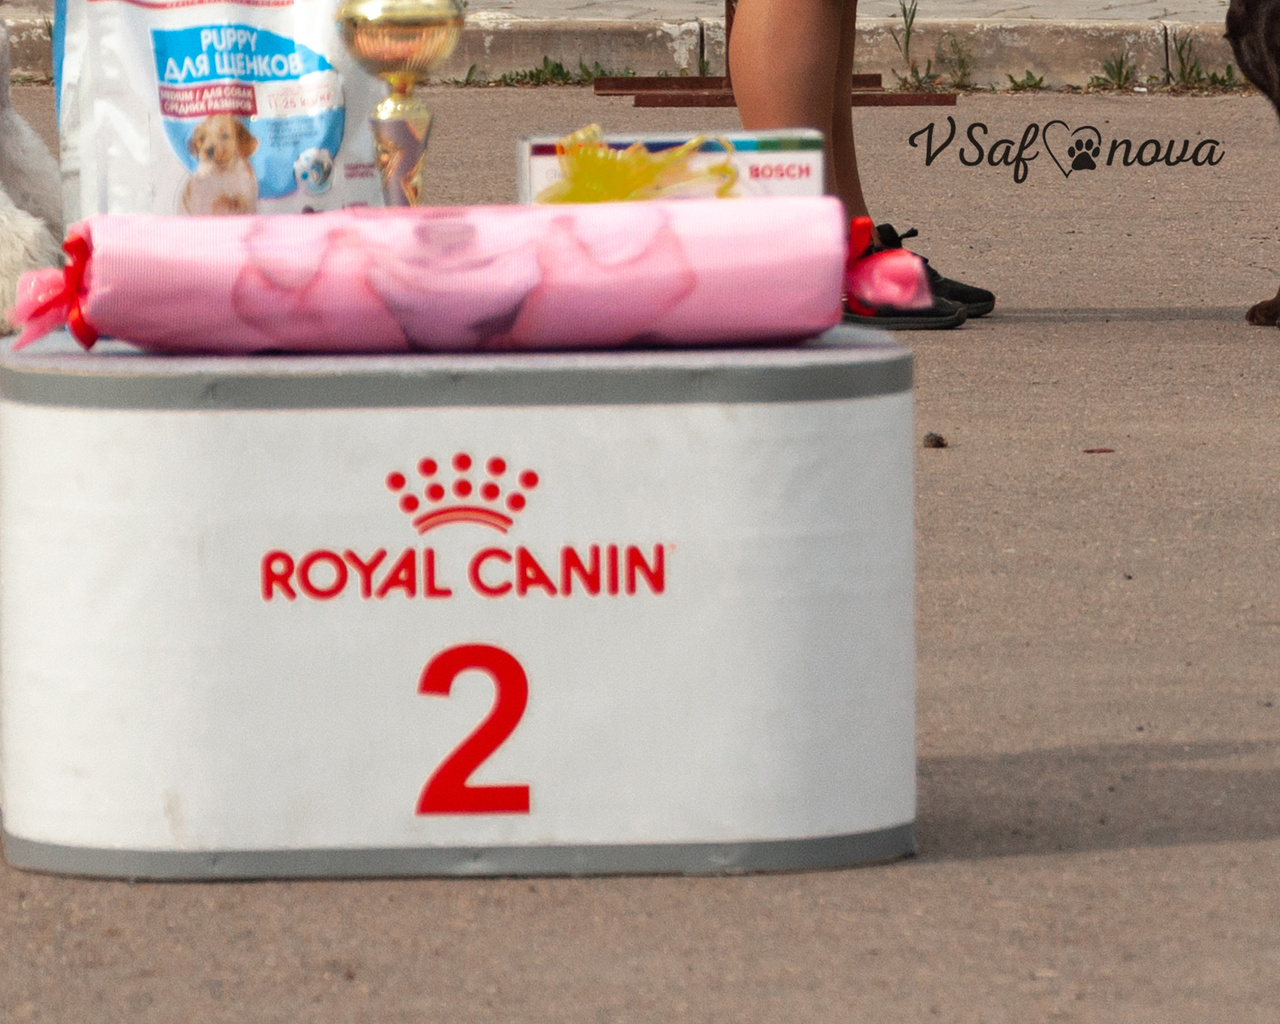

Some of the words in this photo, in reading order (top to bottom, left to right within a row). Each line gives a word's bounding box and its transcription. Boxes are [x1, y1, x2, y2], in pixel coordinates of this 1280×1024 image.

[200, 28, 259, 52] PUPPY
[163, 55, 211, 83] ДЛЯ
[214, 51, 303, 78] ЩЕНКОВ
[748, 163, 812, 180] BOSCH
[260, 547, 453, 603] ROYAL
[467, 542, 666, 598] CANIN
[414, 642, 532, 817] 2
